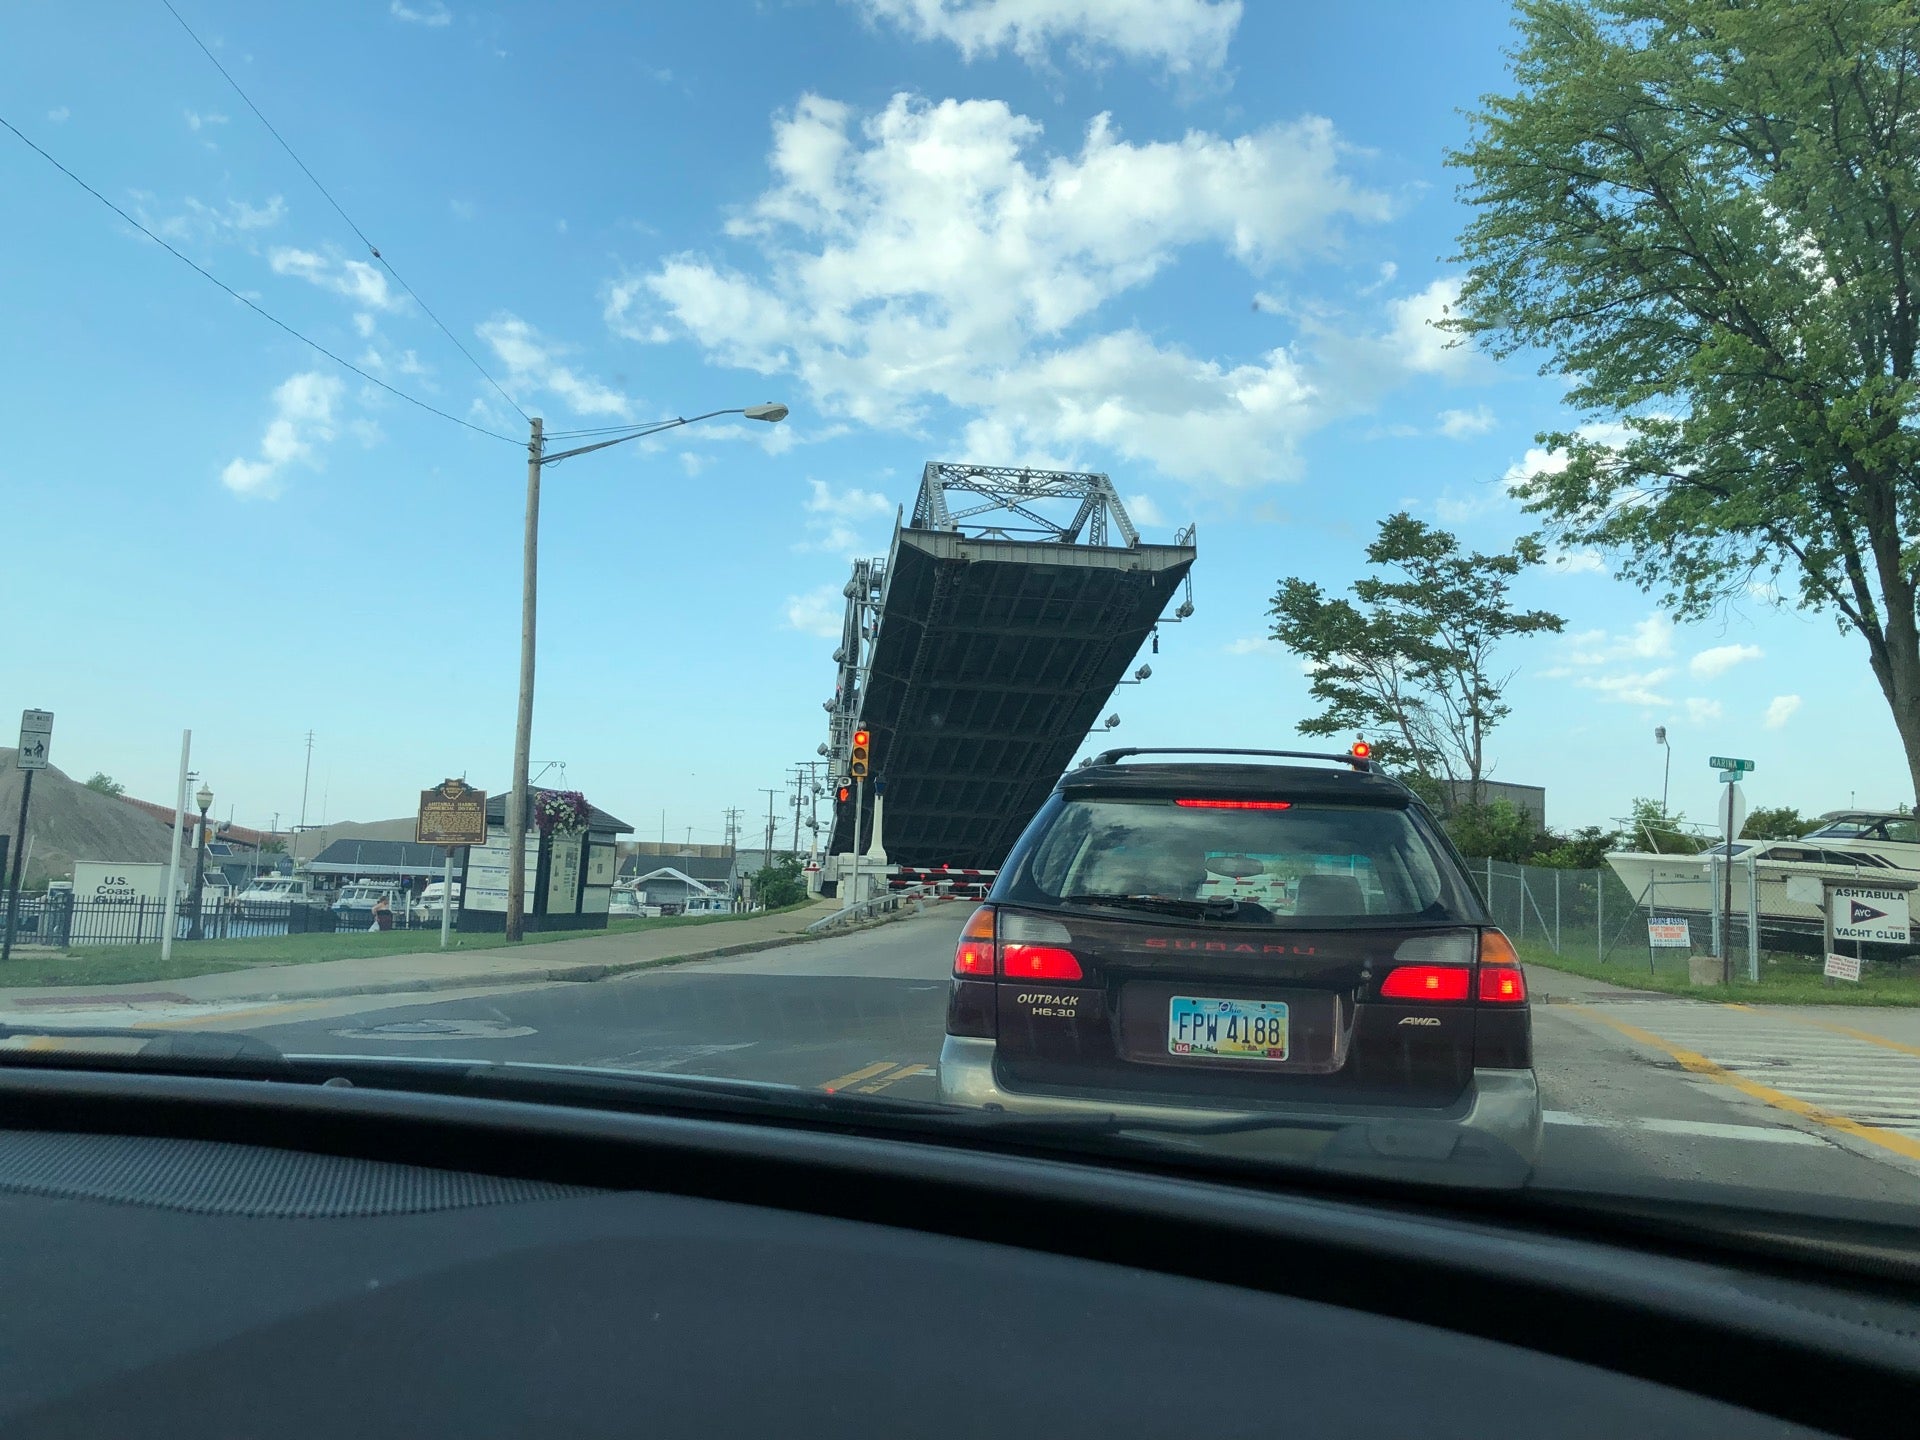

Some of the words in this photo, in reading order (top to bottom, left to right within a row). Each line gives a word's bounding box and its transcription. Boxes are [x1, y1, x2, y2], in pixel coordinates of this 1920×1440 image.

[1711, 757, 1737, 769] MARINA
[1744, 761, 1753, 770] DR
[104, 876, 129, 885] U.S.
[96, 886, 135, 896] Coast
[1835, 888, 1905, 900] ASHTABULA
[1854, 909, 1871, 917] AYC
[1835, 927, 1872, 938] YACHT
[1876, 930, 1906, 940] CLUB
[1145, 939, 1315, 956] SUBARU
[1017, 993, 1079, 1006] OUTBACK
[1398, 1016, 1441, 1026] AWD
[1179, 1013, 1218, 1042] FPW
[1226, 1015, 1280, 1045] 4188
[1176, 1044, 1189, 1052] 04
